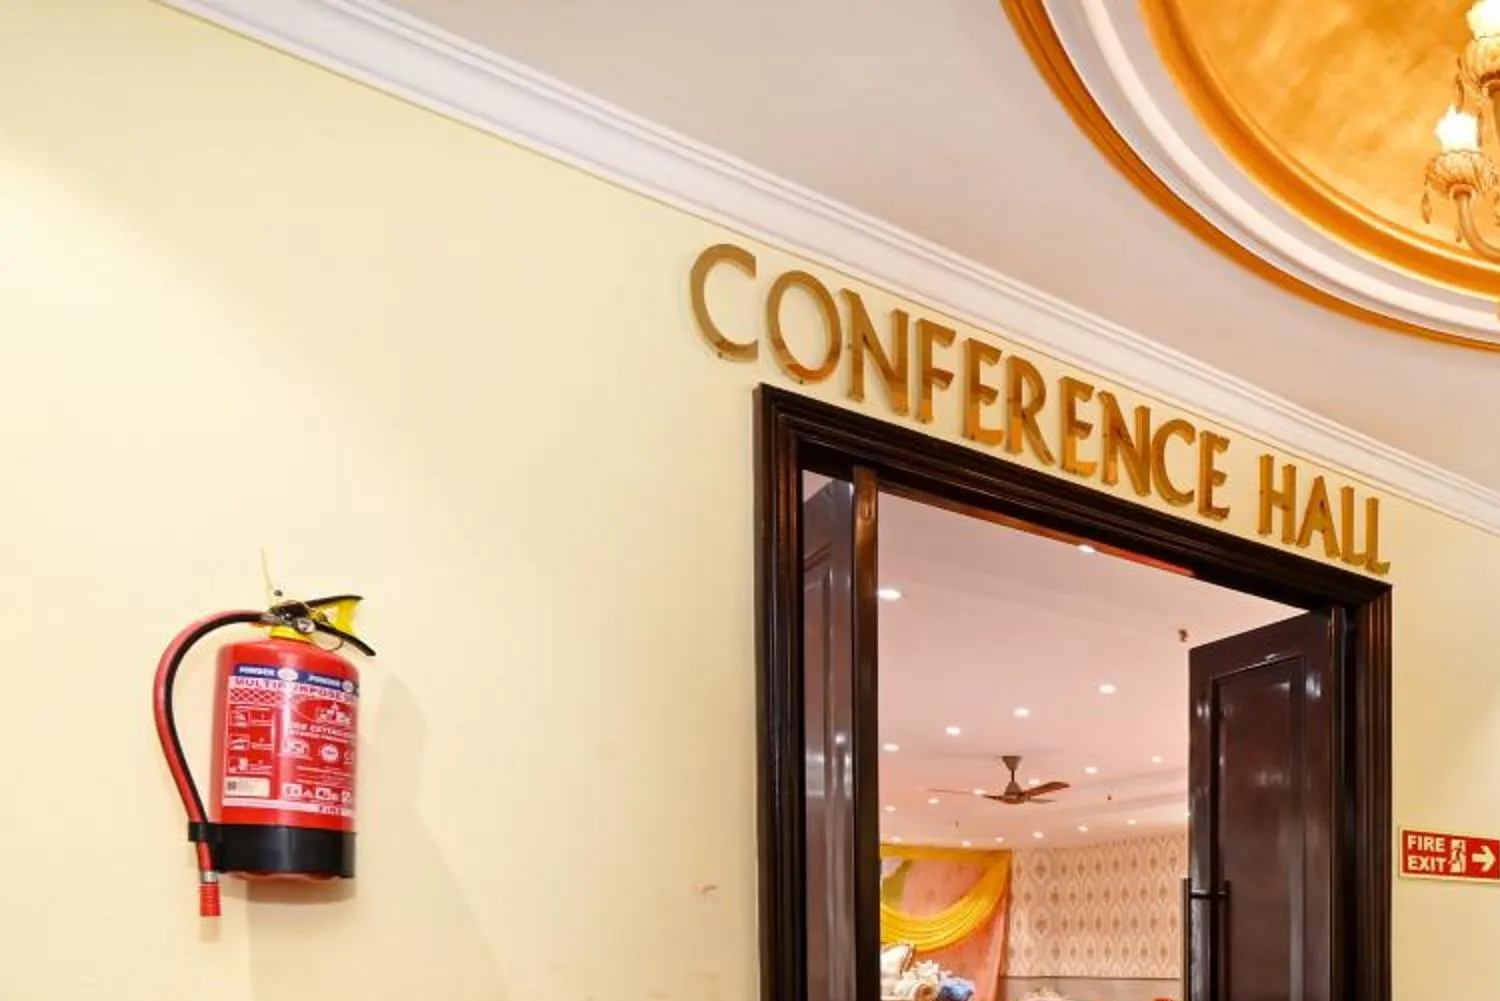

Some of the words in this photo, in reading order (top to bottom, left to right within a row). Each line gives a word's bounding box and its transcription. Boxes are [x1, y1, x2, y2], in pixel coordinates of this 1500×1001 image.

[689, 243, 1231, 521] CONFERENCE
[1256, 453, 1391, 576] HALL
[234, 675, 347, 700] MULTIPRPOSE
[1407, 834, 1446, 853] FIRE
[1407, 855, 1448, 873] EXIT
